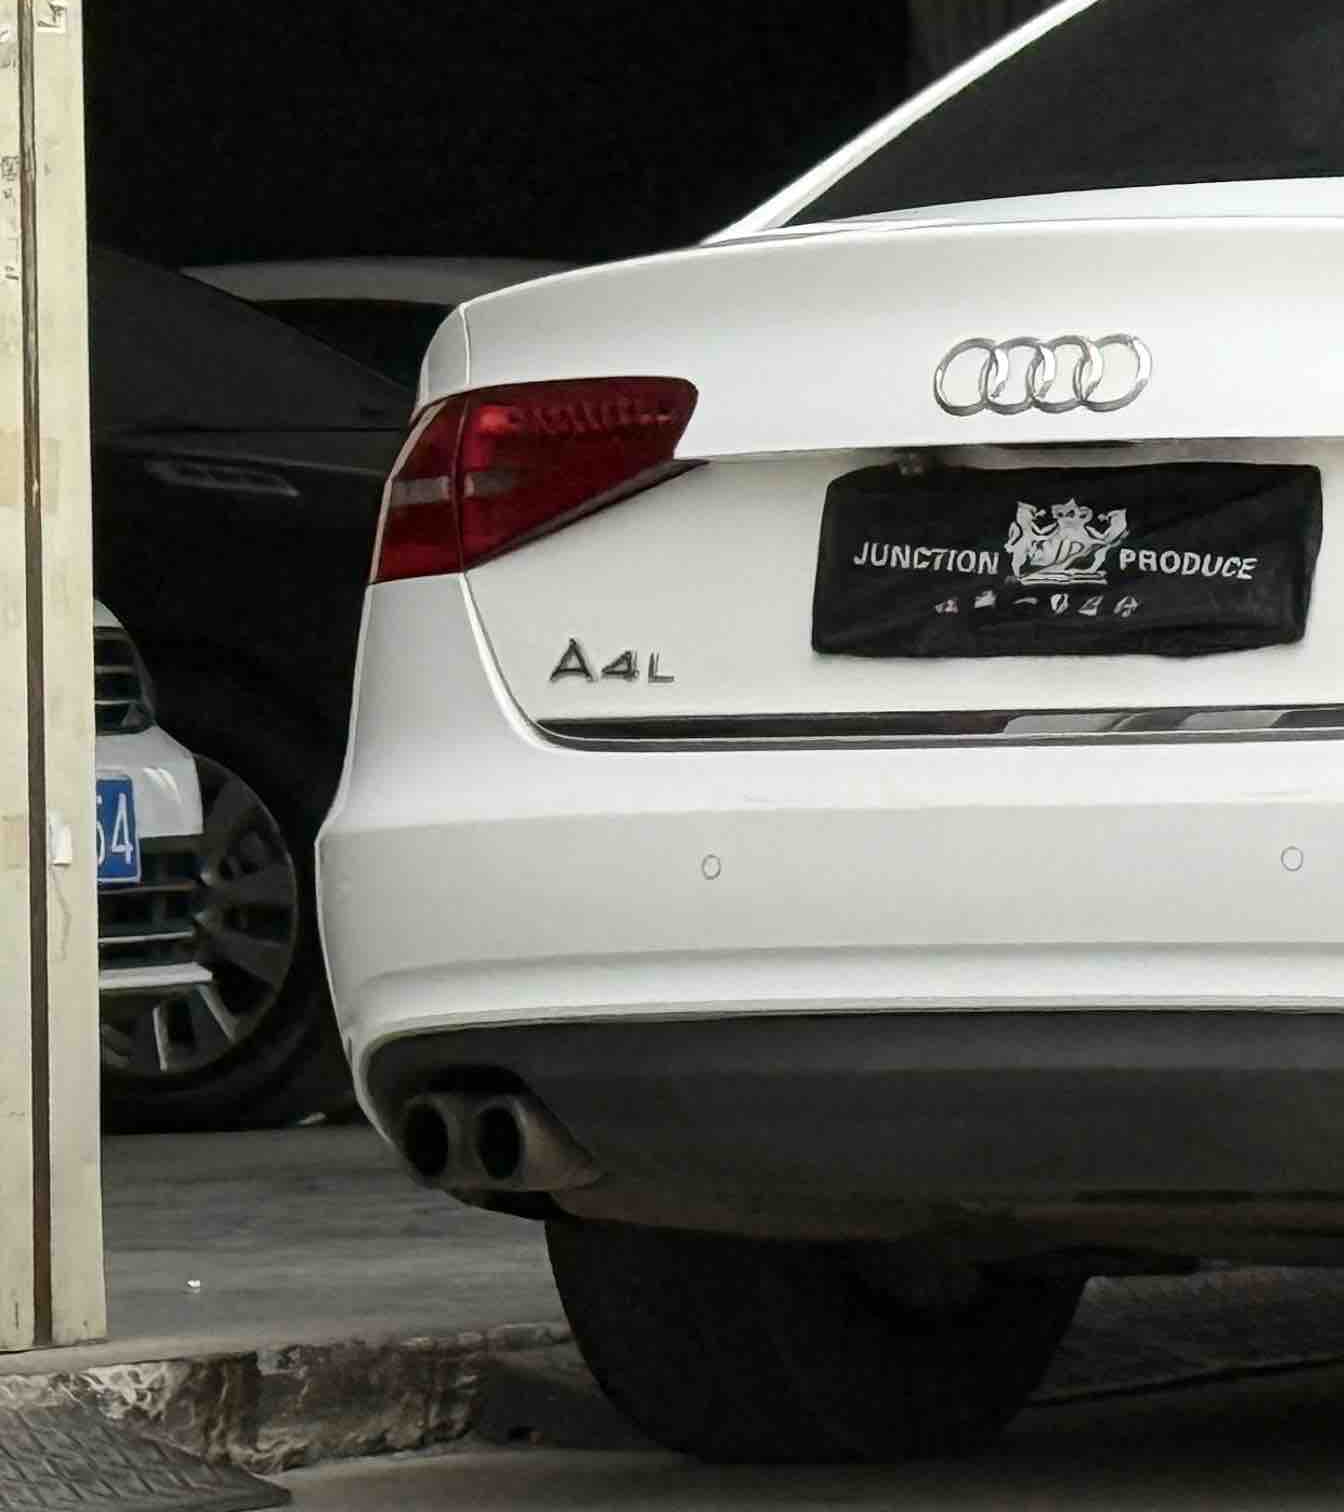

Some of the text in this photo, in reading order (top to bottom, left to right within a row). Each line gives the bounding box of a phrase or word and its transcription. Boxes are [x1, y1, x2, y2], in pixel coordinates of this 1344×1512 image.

[852, 540, 1258, 581] JUNCTION PRODUCE
[549, 638, 675, 684] A4L
